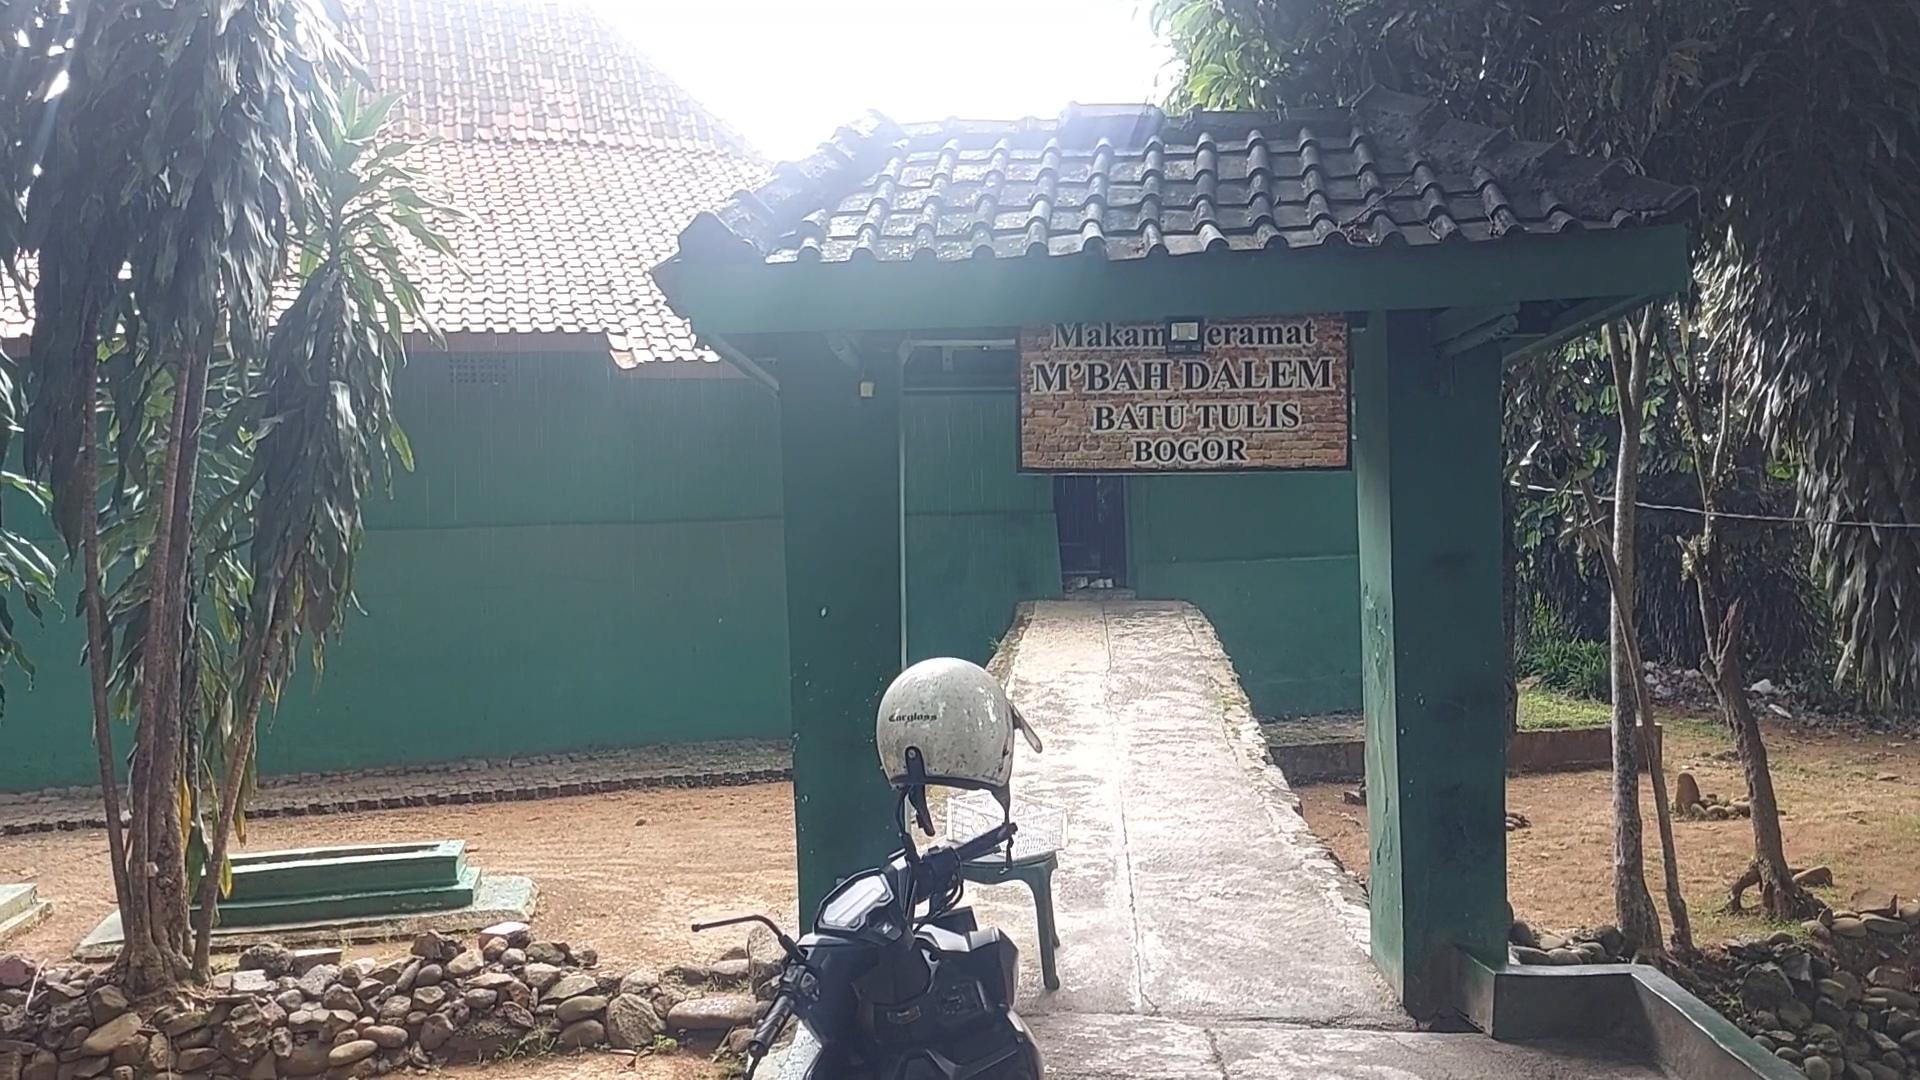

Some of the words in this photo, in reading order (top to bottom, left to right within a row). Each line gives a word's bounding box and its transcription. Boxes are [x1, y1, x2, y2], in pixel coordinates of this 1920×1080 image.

[1053, 321, 1165, 348] Makam
[1206, 319, 1317, 346] eramat
[1183, 358, 1333, 390] DALEM
[1094, 404, 1186, 431] BATU
[1196, 403, 1300, 429] TULIS
[1135, 439, 1246, 462] BOGOR
